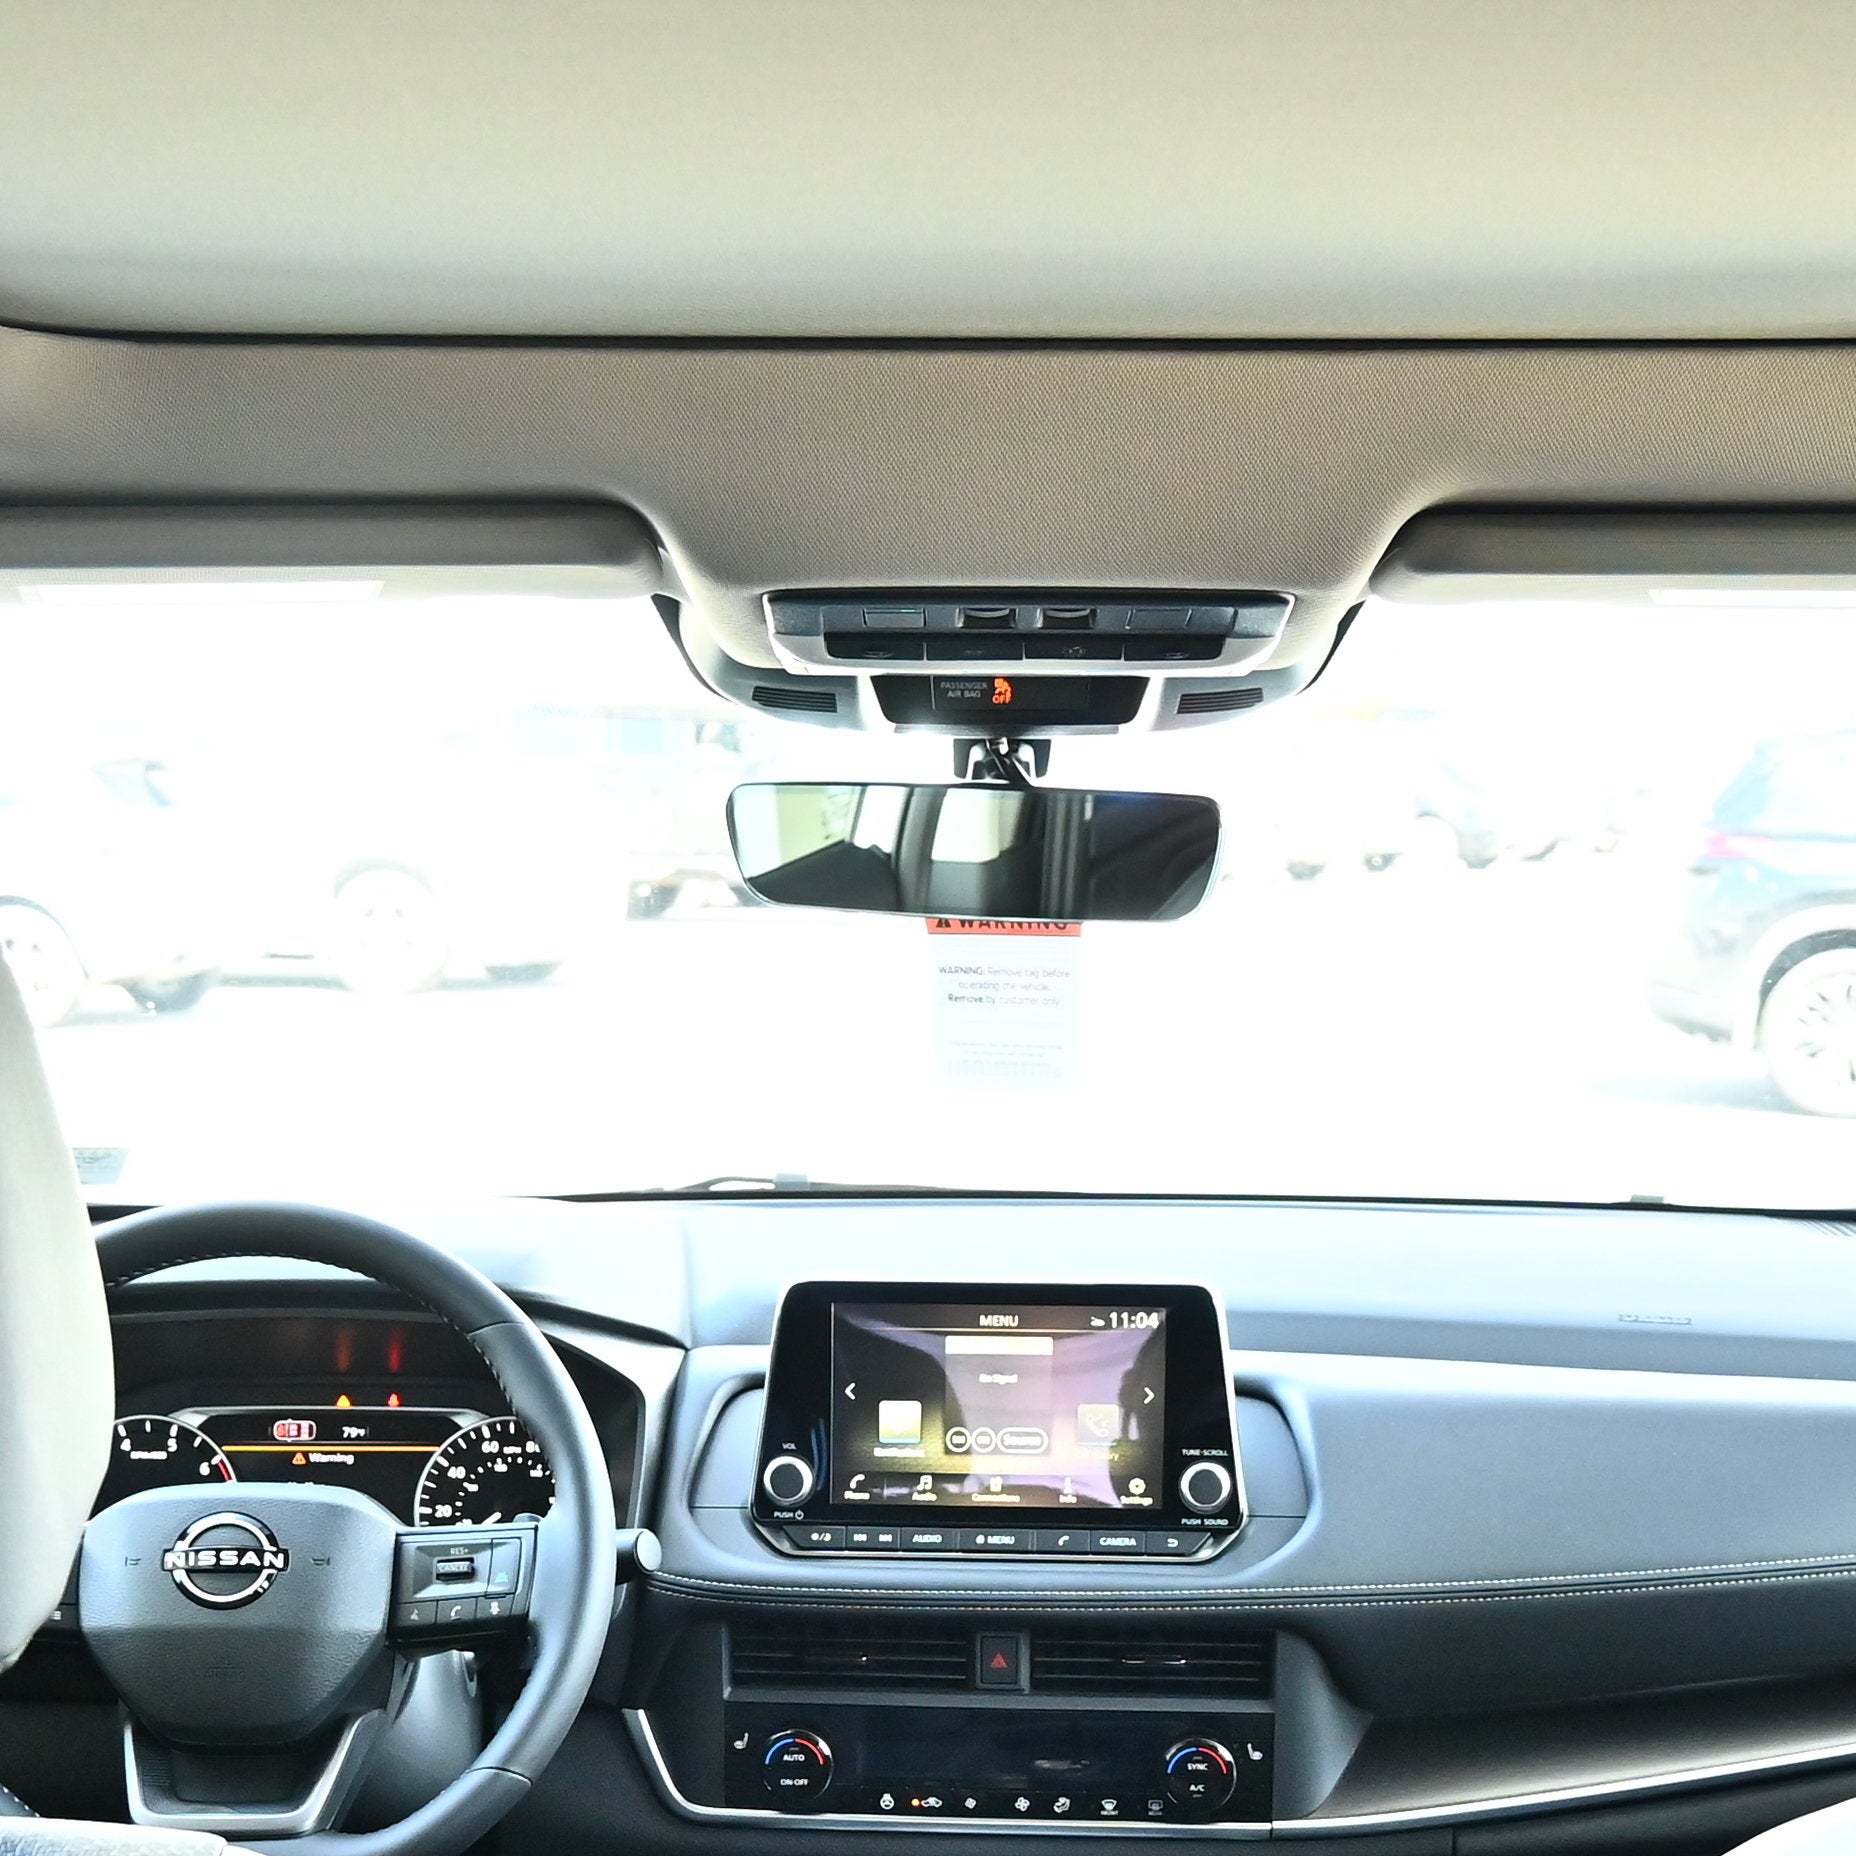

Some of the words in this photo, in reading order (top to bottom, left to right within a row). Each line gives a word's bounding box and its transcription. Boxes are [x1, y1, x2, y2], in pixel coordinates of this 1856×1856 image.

[940, 681, 987, 689] PASSENGER
[947, 690, 961, 698] AIR
[964, 690, 981, 698] BAG
[992, 694, 1011, 704] OFF
[948, 993, 984, 1003] Remove
[979, 1314, 1019, 1328] MENU
[1109, 1311, 1160, 1329] 11:04
[120, 1438, 131, 1451] 4
[167, 1438, 178, 1452] 5
[481, 1441, 500, 1453] 60
[781, 1442, 797, 1450] VOL
[308, 1452, 355, 1465] Warning
[199, 1462, 210, 1475] 6
[447, 1466, 466, 1479] 40
[434, 1504, 452, 1517] 20
[1181, 1518, 1201, 1526] PUSH
[1203, 1518, 1229, 1526] SOUND
[912, 1534, 943, 1543] AUDIO
[987, 1535, 1015, 1544] MENU
[1099, 1537, 1137, 1546] CAMERA
[164, 1550, 285, 1569] NISSAN
[782, 1753, 806, 1762] AUTO
[1187, 1762, 1209, 1771] SYNC
[1189, 1784, 1206, 1792] A/C
